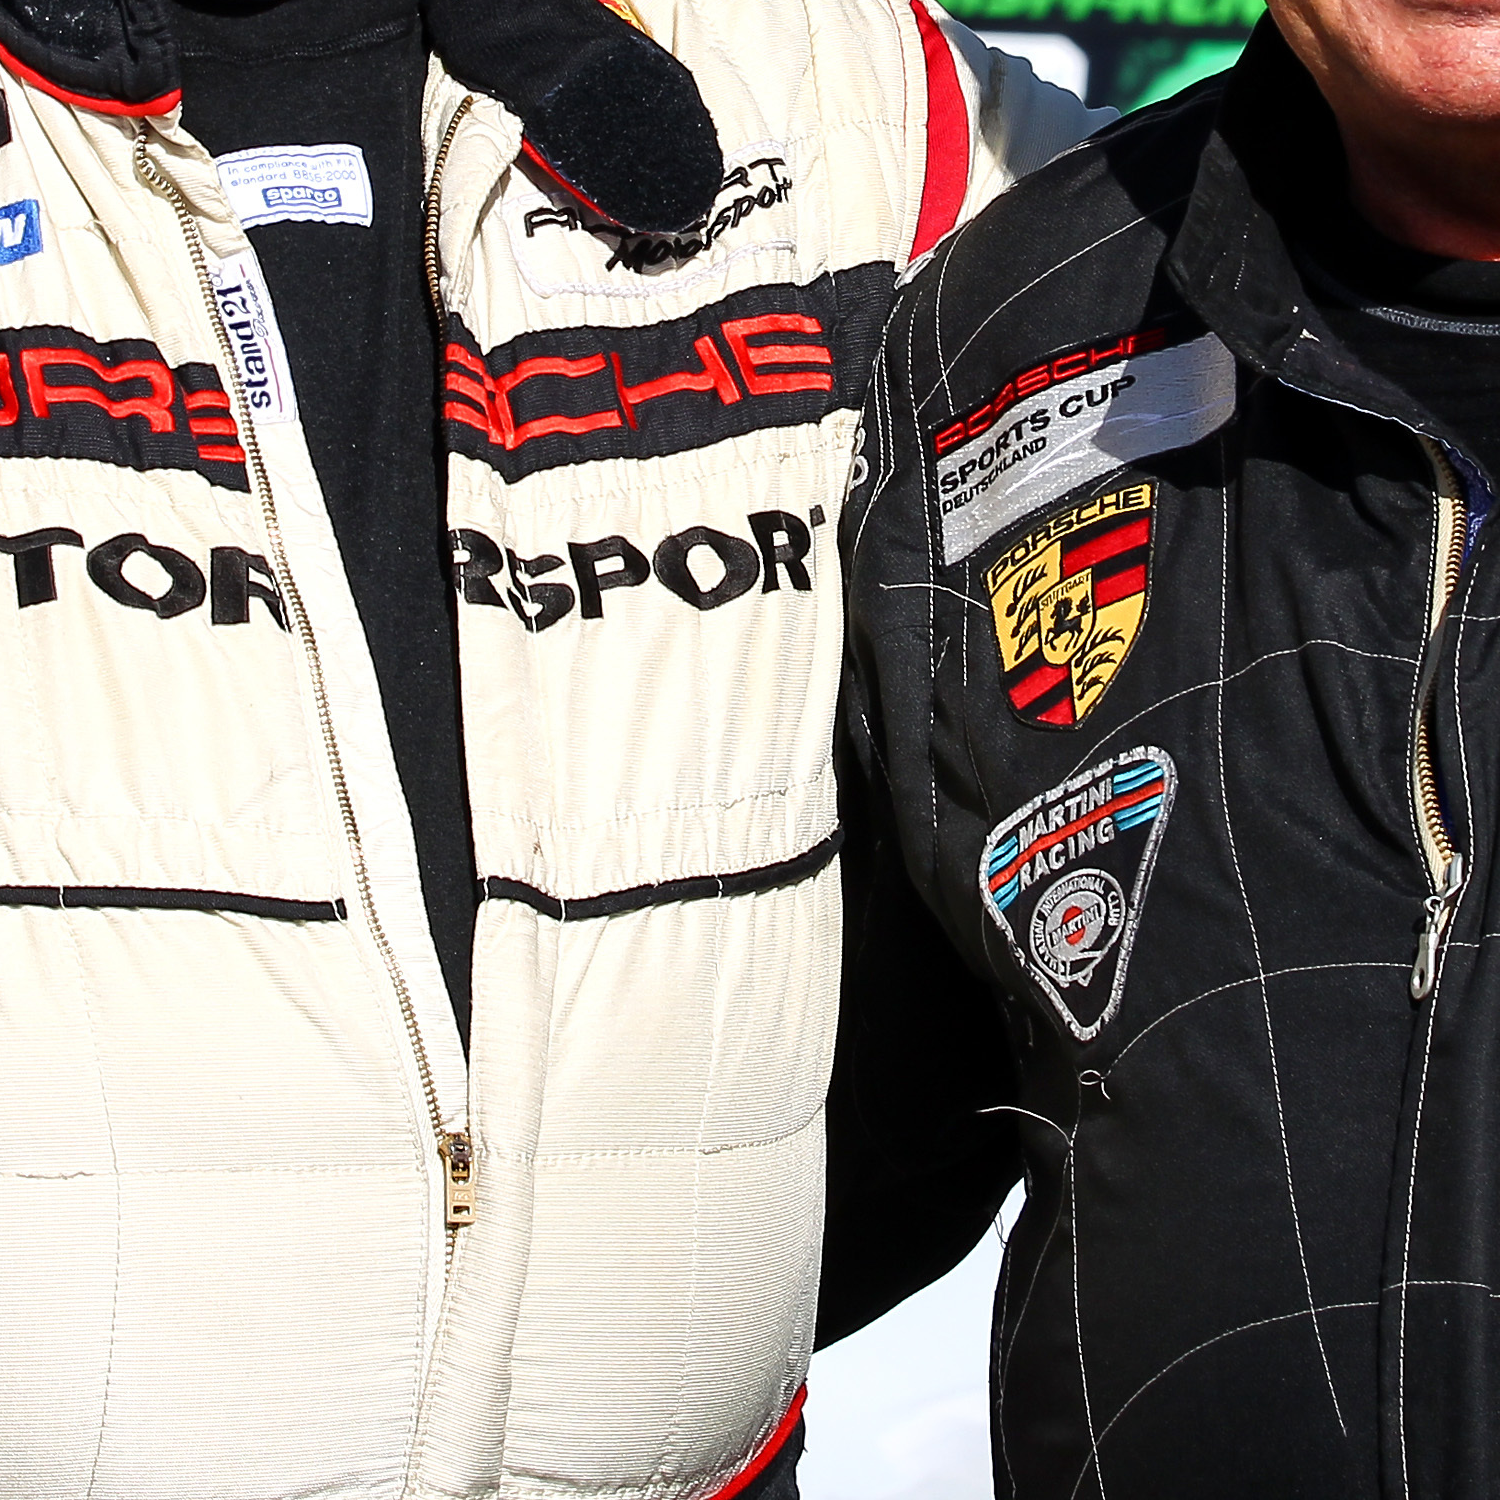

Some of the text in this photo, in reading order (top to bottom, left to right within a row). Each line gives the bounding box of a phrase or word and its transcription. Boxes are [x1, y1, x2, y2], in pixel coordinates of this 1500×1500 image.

[266, 187, 338, 204] sparco
[934, 327, 1165, 455] PORSCHE
[940, 374, 1138, 495] SPORTS CUP
[941, 436, 1048, 516] DEUTSCHLAND
[990, 486, 1146, 587] PORSCHE
[1017, 777, 1113, 853] MARTINI
[1019, 815, 1117, 892] RACING
[1049, 903, 1101, 947] MARTINI
